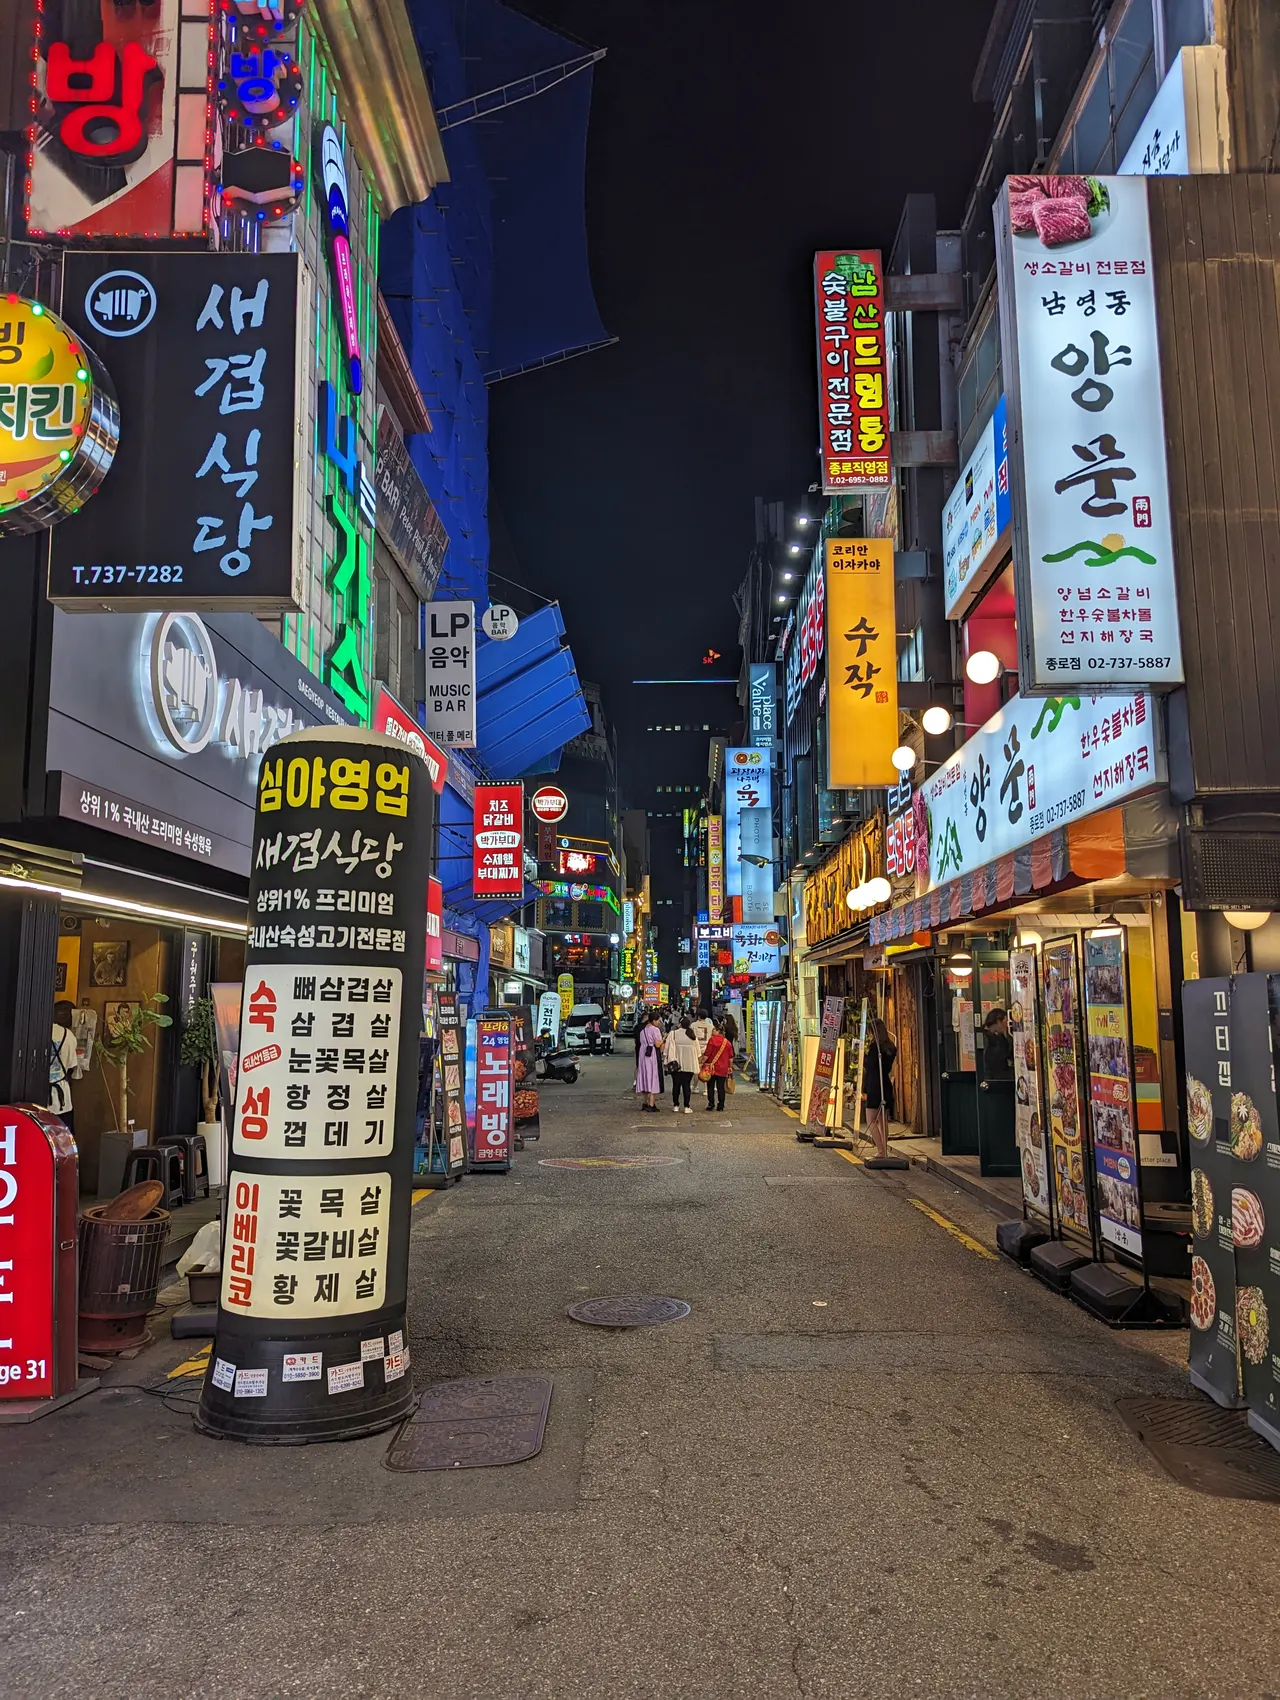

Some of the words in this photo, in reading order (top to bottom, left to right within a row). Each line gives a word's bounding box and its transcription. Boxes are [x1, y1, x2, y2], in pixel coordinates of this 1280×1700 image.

[1024, 261, 1091, 275] 생소갈비
[1096, 261, 1146, 275] 전문점
[1041, 290, 1131, 316] 남영동
[822, 271, 853, 453] 숯불구이전문점
[193, 278, 273, 577] 새겹식당
[829, 461, 888, 475] 종로직영점
[832, 545, 869, 556] 코리안
[832, 559, 880, 571] 이자카야
[72, 565, 184, 585] T.737-7282
[490, 609, 510, 621] LP
[1059, 608, 1152, 622] 한우숯불차돌
[430, 613, 470, 638] LP
[429, 646, 470, 670] 음악
[703, 656, 713, 664] SK
[843, 616, 882, 700] 수작
[1045, 657, 1081, 671] 종로점
[1087, 657, 1172, 669] 02-737-5887
[429, 684, 471, 697] MUSIC
[434, 700, 467, 712] BAR
[762, 694, 776, 730] place
[260, 756, 410, 818] 심야영업
[489, 800, 509, 811] 치즈
[79, 790, 101, 818] 상위
[122, 806, 150, 834] 국내산
[151, 815, 184, 848] 프리미엄
[184, 825, 213, 857] 숙성원육
[483, 813, 514, 826] 닭갈비
[480, 835, 517, 846] 박가부대
[255, 828, 404, 879] 새겹식당
[483, 853, 514, 865] 수제햄
[478, 867, 518, 879] 부대찌개
[315, 889, 394, 916] 프리미엄
[293, 976, 393, 1003] 뼈삼겹살
[482, 1036, 496, 1047] 24
[288, 1048, 389, 1074] 눈꽃목살
[480, 1052, 513, 1146] 노래방
[228, 1182, 260, 1307] 이베리코
[276, 1227, 379, 1262] 꽃갈비살
[26, 1360, 47, 1379] 31
[386, 1355, 401, 1371] 카드
